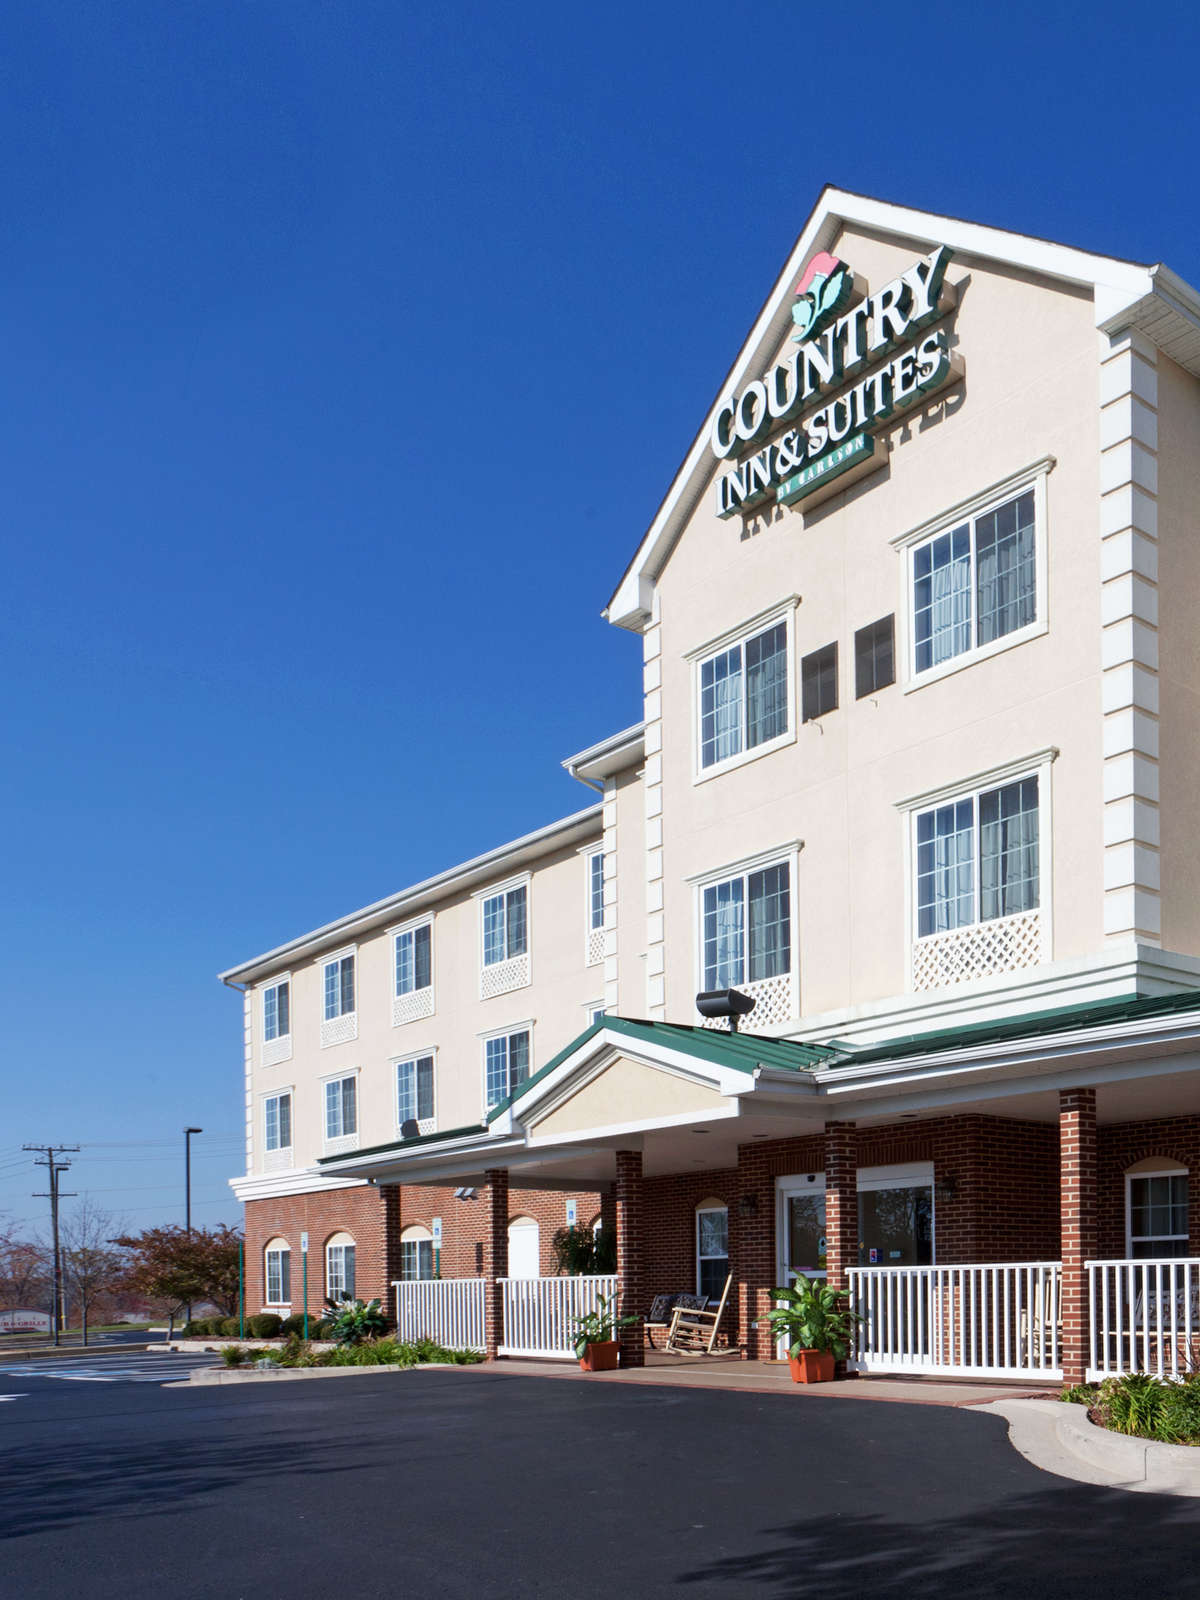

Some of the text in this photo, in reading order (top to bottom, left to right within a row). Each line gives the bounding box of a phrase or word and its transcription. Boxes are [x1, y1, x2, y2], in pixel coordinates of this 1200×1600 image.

[711, 245, 952, 460] COUNTRY
[715, 445, 773, 518] INN
[808, 331, 948, 458] SUITES
[776, 435, 865, 501] BY CARLSON
